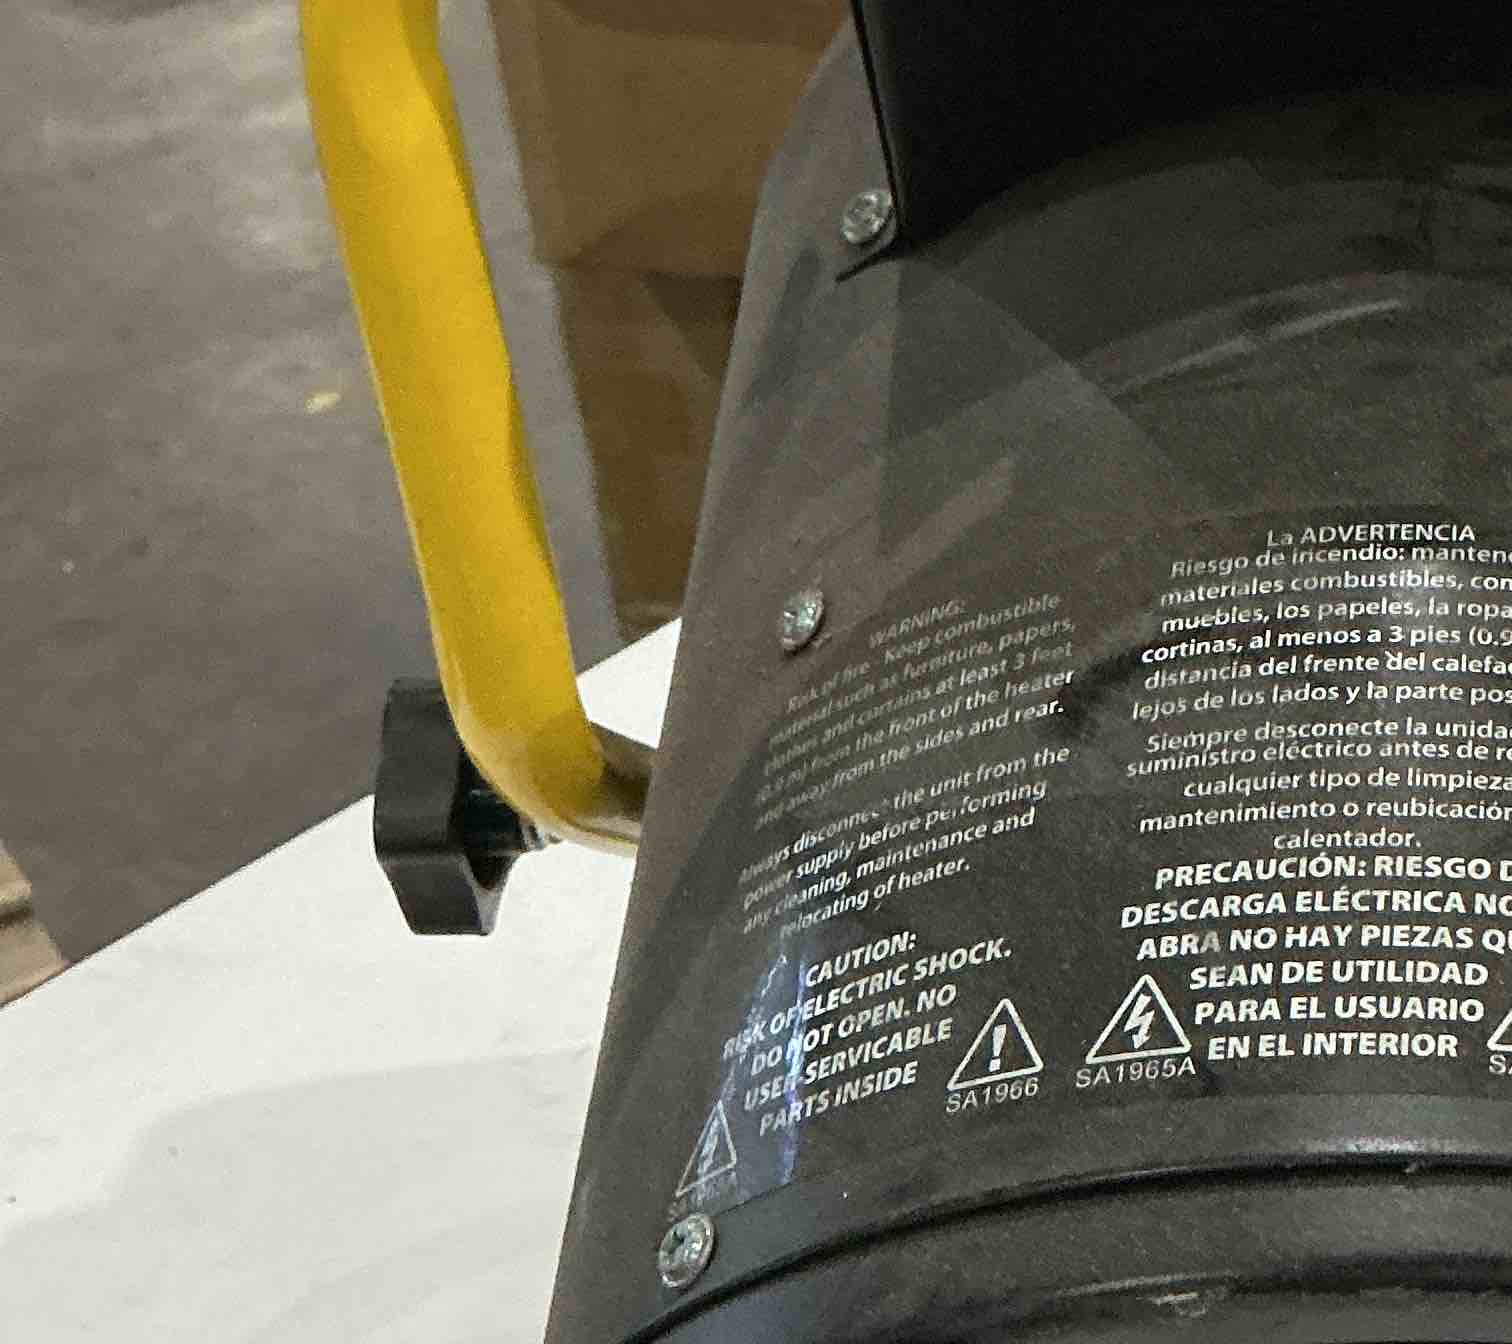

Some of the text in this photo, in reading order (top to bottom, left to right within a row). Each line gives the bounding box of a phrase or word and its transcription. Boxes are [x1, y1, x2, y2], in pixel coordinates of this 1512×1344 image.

[1267, 524, 1475, 546] La ADVERTENCIA
[1171, 557, 1249, 578] Riesgo
[1256, 550, 1284, 568] de
[1292, 544, 1405, 563] incendio:
[1160, 576, 1284, 607] materiales
[1291, 570, 1464, 594] combustibles,
[1162, 607, 1269, 633] muebles,
[1276, 602, 1310, 620] los
[1318, 598, 1421, 622] papeles,
[1428, 598, 1449, 617] la
[1141, 636, 1244, 663] cortinas,
[1250, 630, 1271, 649] al
[1278, 627, 1360, 646] menos
[1410, 625, 1460, 647] pies
[1144, 663, 1252, 691] distancia
[1258, 656, 1296, 676] del
[1303, 654, 1379, 674] frente
[1385, 650, 1425, 671] del
[968, 697, 1064, 736] and rear.
[1132, 697, 1187, 721] lejos
[1194, 691, 1223, 711] de
[1231, 687, 1265, 706] los
[1272, 684, 1339, 703] lados
[1367, 681, 1387, 699] la
[1395, 683, 1463, 703] parte
[1146, 726, 1246, 754] Siempre
[1254, 719, 1399, 742] desconecte
[1406, 717, 1427, 736] la
[1263, 739, 1371, 760] eléctrico
[1379, 740, 1449, 758] antes
[1456, 742, 1488, 760] de
[894, 745, 1071, 809] the unit the
[1183, 769, 1301, 797] cualquier
[1308, 767, 1360, 789] tipo
[1367, 767, 1399, 785] de
[1139, 802, 1336, 833] mantenimiento
[797, 814, 921, 881] supply before
[856, 808, 1035, 877] maintenance and
[1273, 828, 1421, 849] calentador.
[874, 854, 970, 898] of heater.
[1155, 851, 1366, 890] PRECAUCIÓN:
[1373, 856, 1491, 881] RIESGO
[1120, 892, 1286, 929] DESCARGA
[1295, 885, 1463, 914] ELÉCTRICA
[804, 931, 917, 987] CAUTION:
[1136, 931, 1221, 960] ABRA
[1229, 928, 1276, 951] NO
[1284, 925, 1351, 948] HAY
[1361, 926, 1473, 949] PIEZAS
[799, 937, 1011, 1021] ELECTRIC SHOCK.
[1189, 960, 1488, 990] SEAN DE UTILIDAD
[751, 983, 958, 1075] DO OPEN. NO
[1194, 996, 1484, 1025] PARA EL USUARIO
[804, 1017, 953, 1089] SERVICABLE
[1208, 1033, 1458, 1060] EN EL INTERIOR
[834, 1061, 919, 1106] INSIDE
[1074, 1060, 1197, 1089] SA1965A
[945, 1077, 1039, 1114] SA1966
